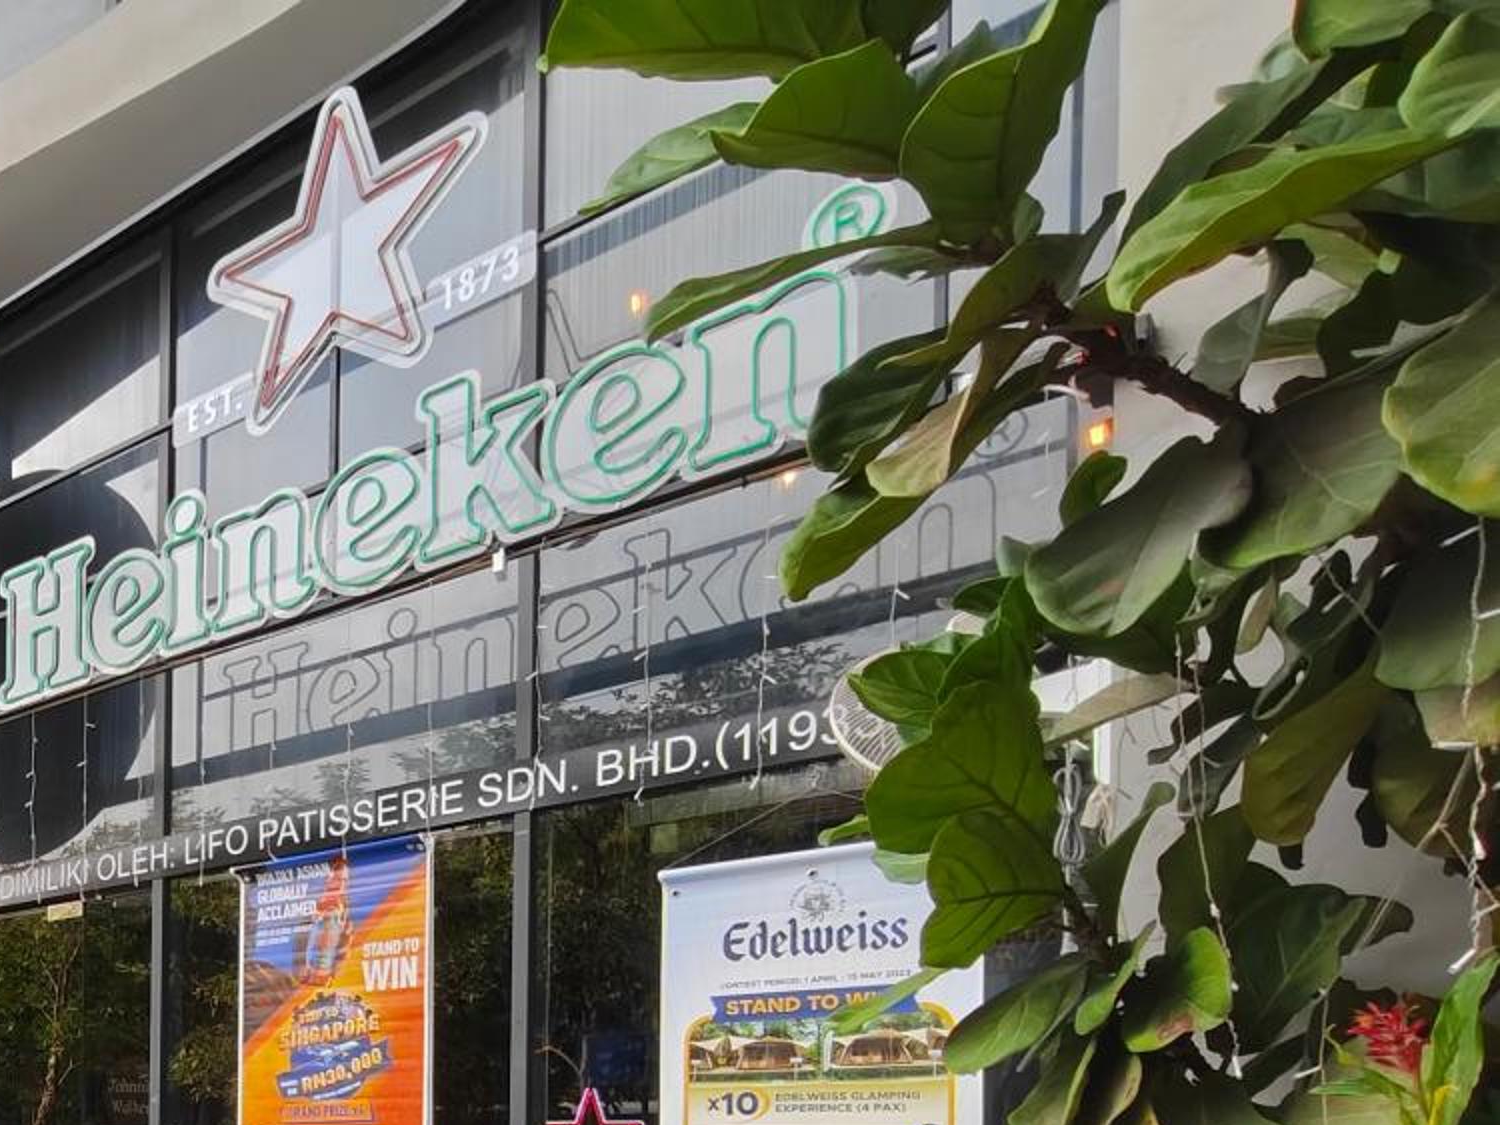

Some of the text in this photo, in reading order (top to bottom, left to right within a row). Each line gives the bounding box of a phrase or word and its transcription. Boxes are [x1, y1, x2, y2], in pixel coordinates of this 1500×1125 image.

[441, 248, 520, 311] 1873
[186, 385, 244, 433] EST.
[0, 862, 90, 900] DIMILIKI
[97, 845, 176, 882] OLEH:
[183, 825, 250, 866] LIFO
[258, 778, 465, 851] PATISSERIE
[477, 758, 579, 804] SDN.
[257, 883, 309, 905] GLOBALLY
[362, 937, 420, 958] STAND TO
[722, 909, 909, 962] Edelweiss
[362, 954, 418, 992] WIN
[725, 996, 801, 1016] STAND
[806, 993, 840, 1012] TO
[278, 1013, 381, 1052] SINGAPORE
[708, 1091, 759, 1117] x10
[774, 1090, 922, 1102] EDELWEISS GLAMPING
[774, 1104, 854, 1114] EXPERIENCE
[873, 1102, 908, 1113] PAX)
